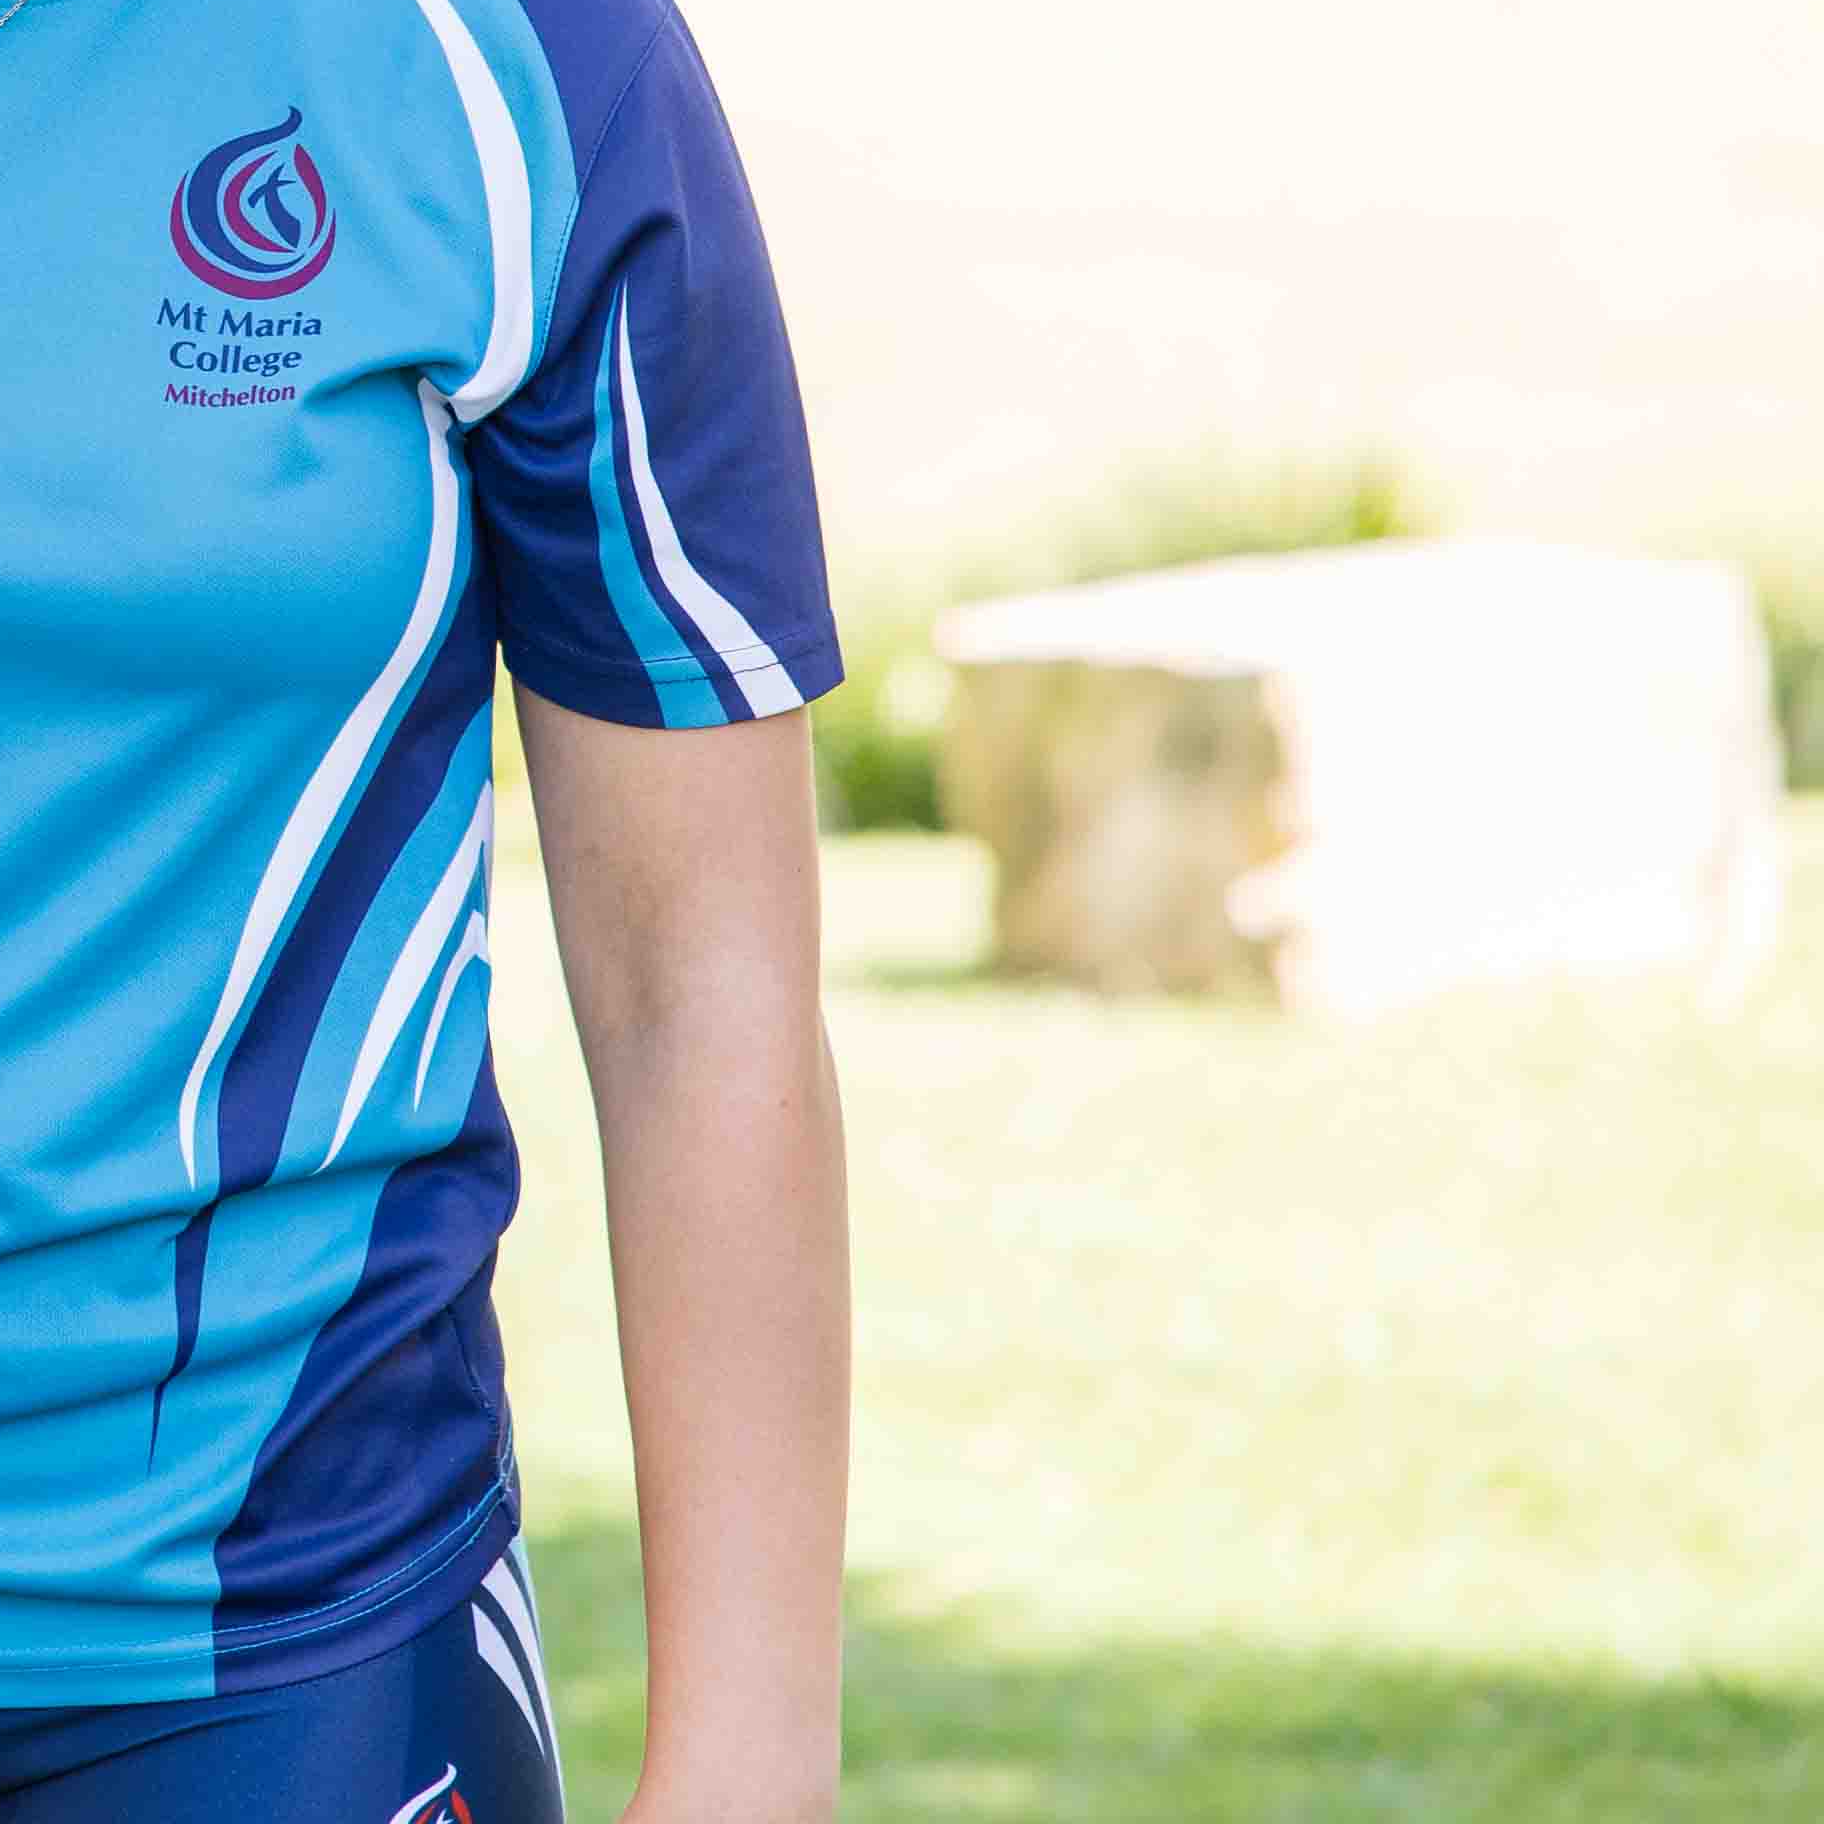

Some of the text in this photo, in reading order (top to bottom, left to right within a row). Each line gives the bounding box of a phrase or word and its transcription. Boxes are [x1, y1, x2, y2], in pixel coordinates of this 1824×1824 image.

[156, 297, 323, 338] Mt Maria
[169, 340, 303, 377] College
[164, 382, 296, 408] Mitchelton
